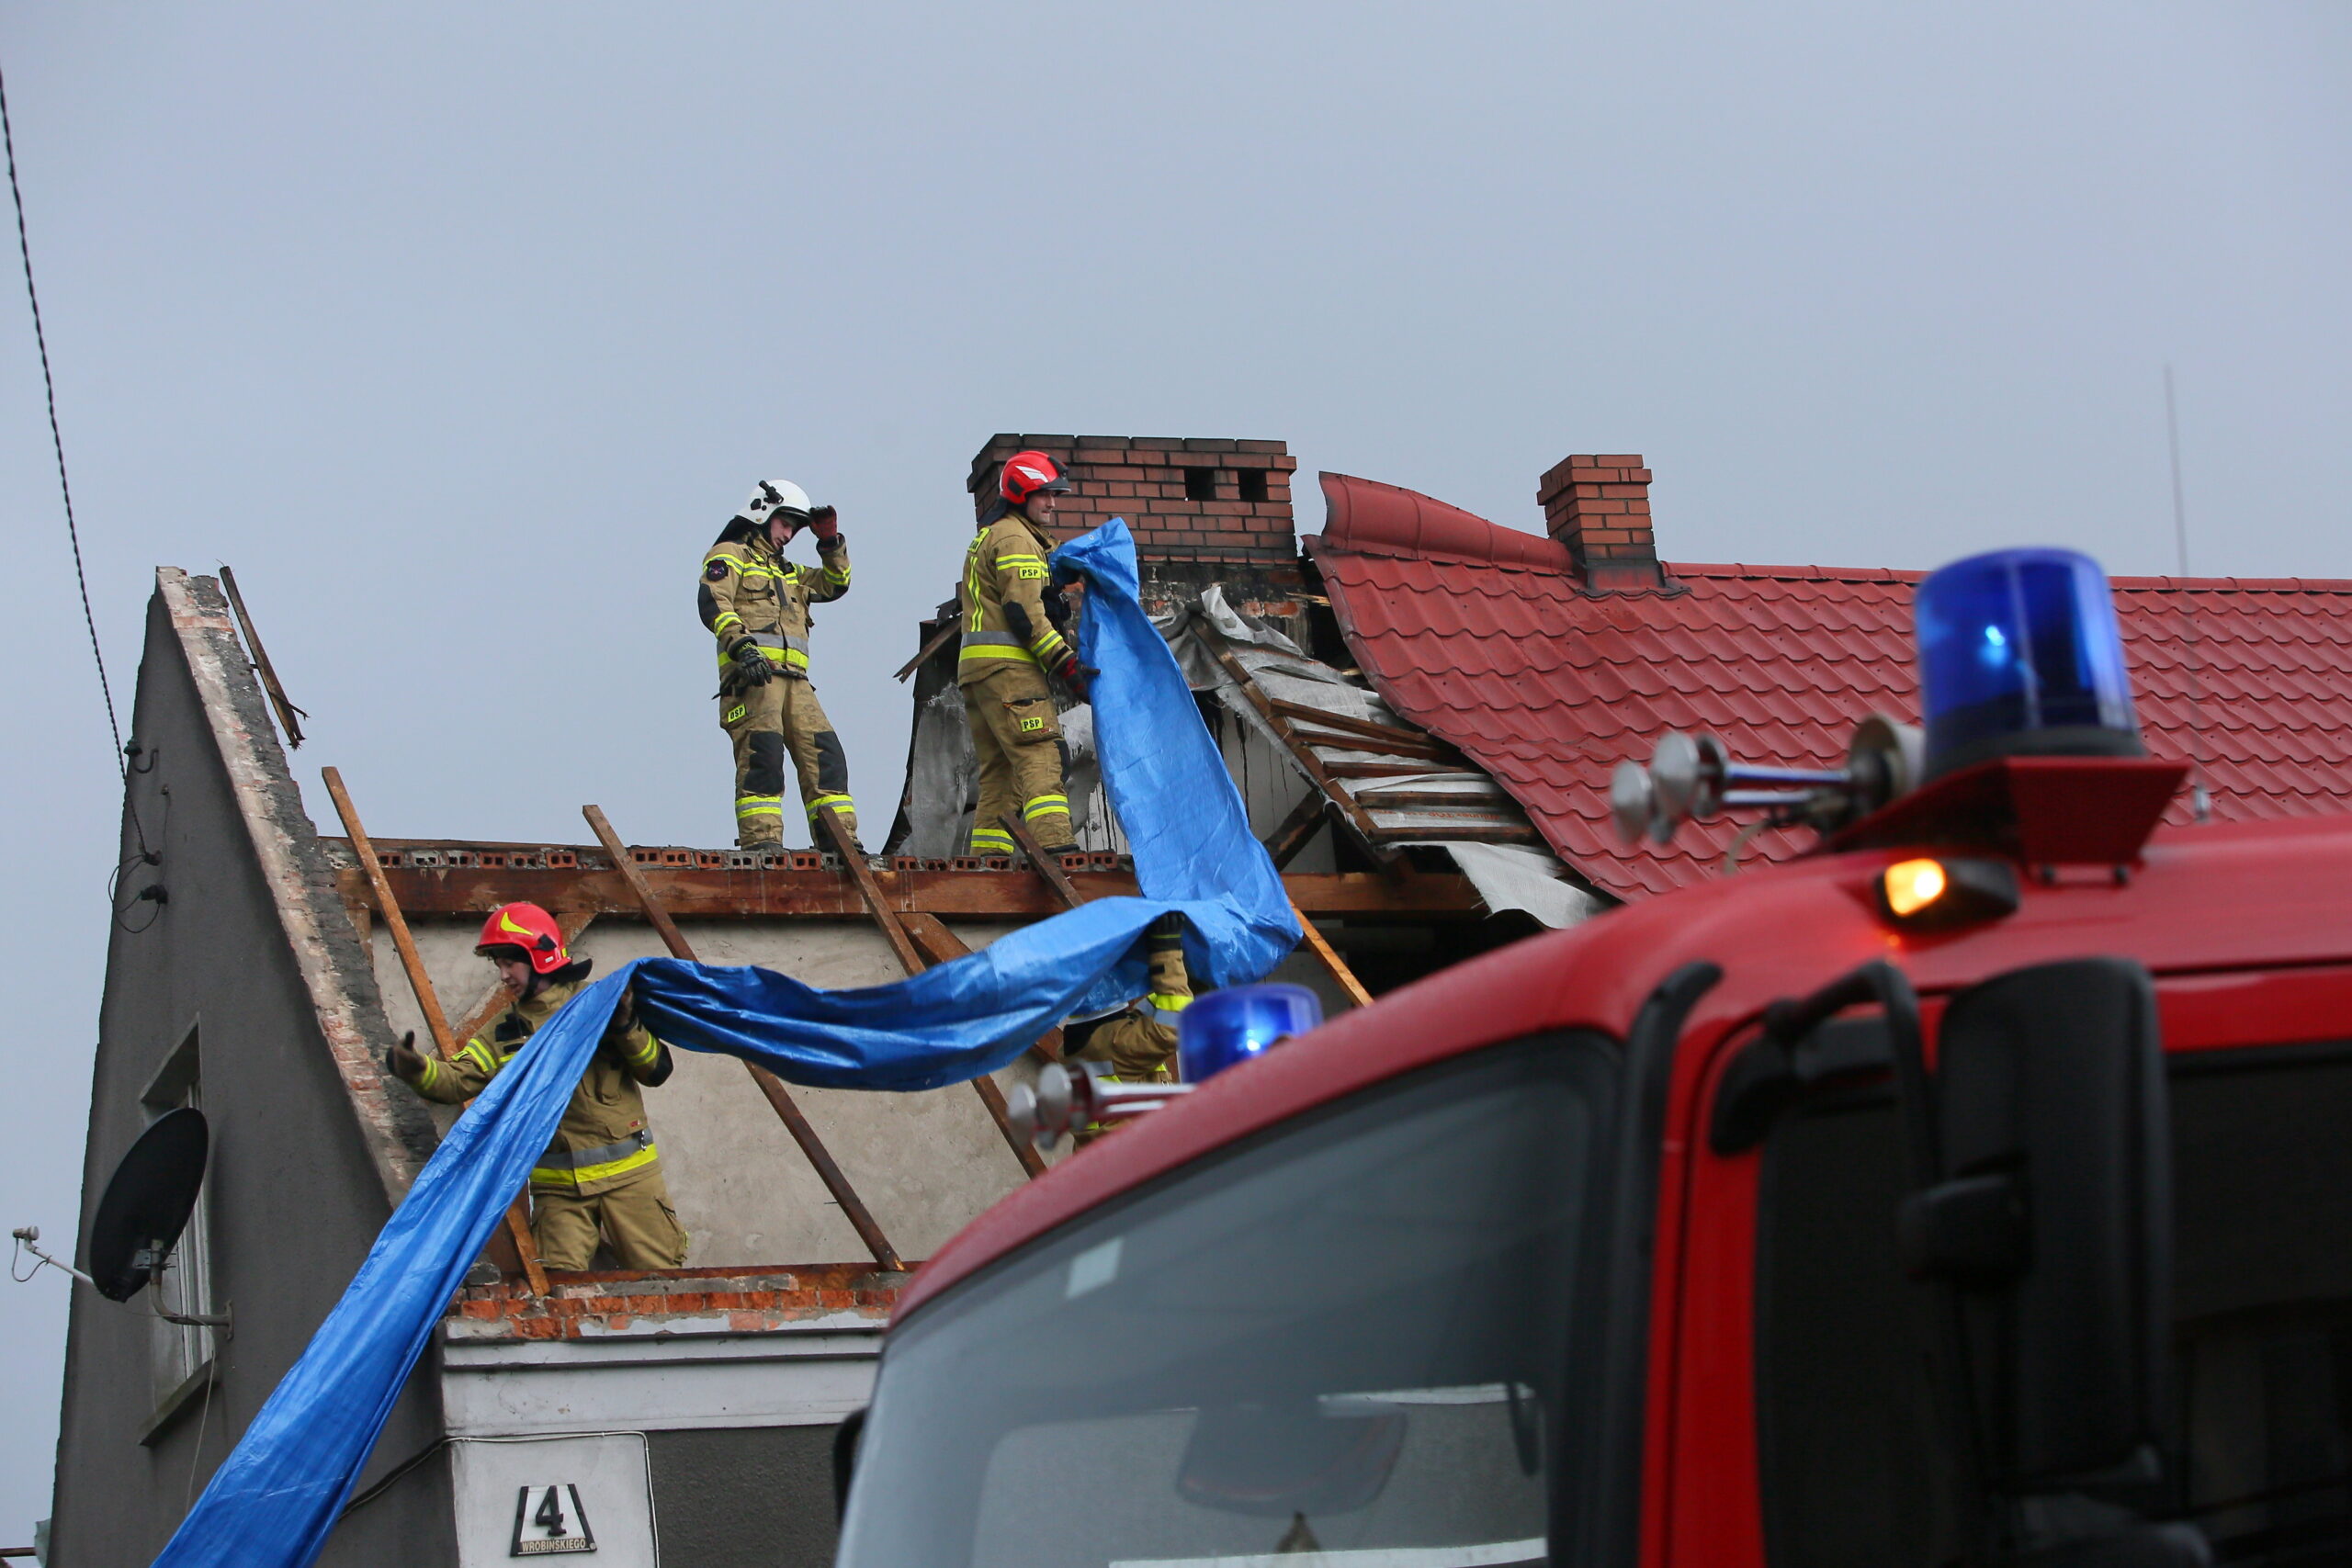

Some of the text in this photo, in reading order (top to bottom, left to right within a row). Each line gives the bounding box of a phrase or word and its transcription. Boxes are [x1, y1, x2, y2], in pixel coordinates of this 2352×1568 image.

[1023, 569, 1038, 577] PSP
[1023, 719, 1040, 728] PSP
[536, 1485, 567, 1536] 4
